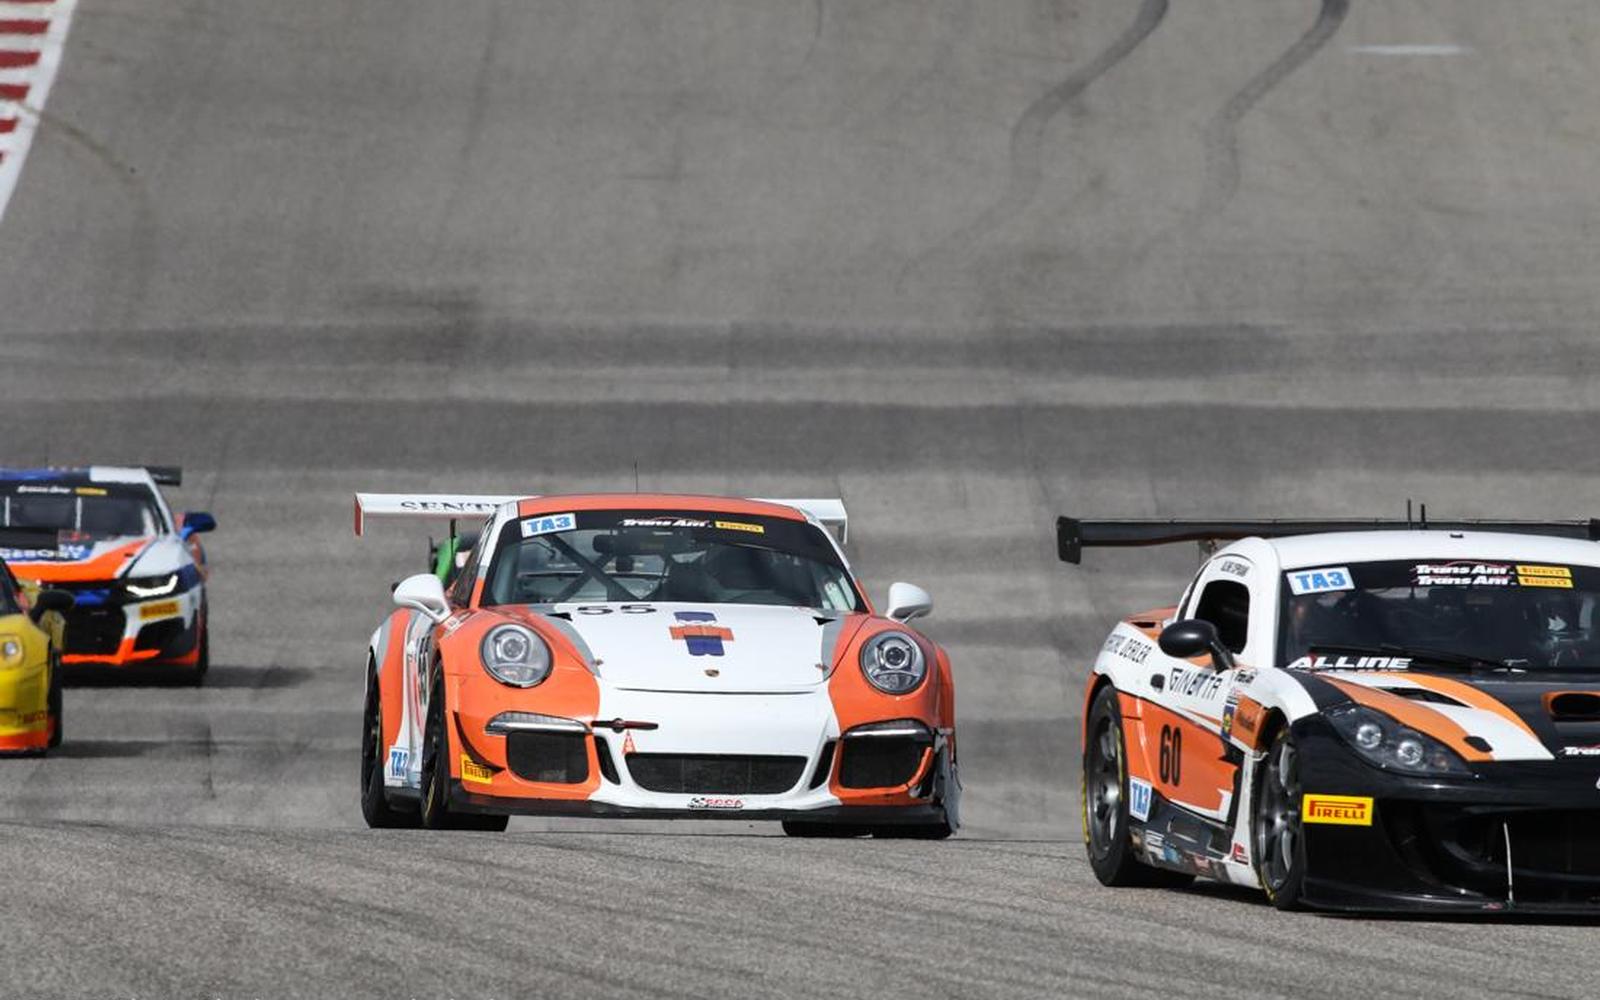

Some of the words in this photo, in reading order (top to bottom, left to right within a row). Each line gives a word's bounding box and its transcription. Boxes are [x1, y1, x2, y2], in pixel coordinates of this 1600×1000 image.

[527, 516, 571, 533] TA3
[1416, 564, 1470, 575] Trans
[1471, 564, 1510, 575] Am
[1295, 571, 1346, 590] TA3
[1418, 575, 1471, 585] Trans
[1473, 575, 1512, 585] Am
[577, 605, 657, 615] 55
[1159, 723, 1182, 788] 60
[1131, 781, 1149, 817] TA3
[1309, 799, 1367, 820] PIRELLI
